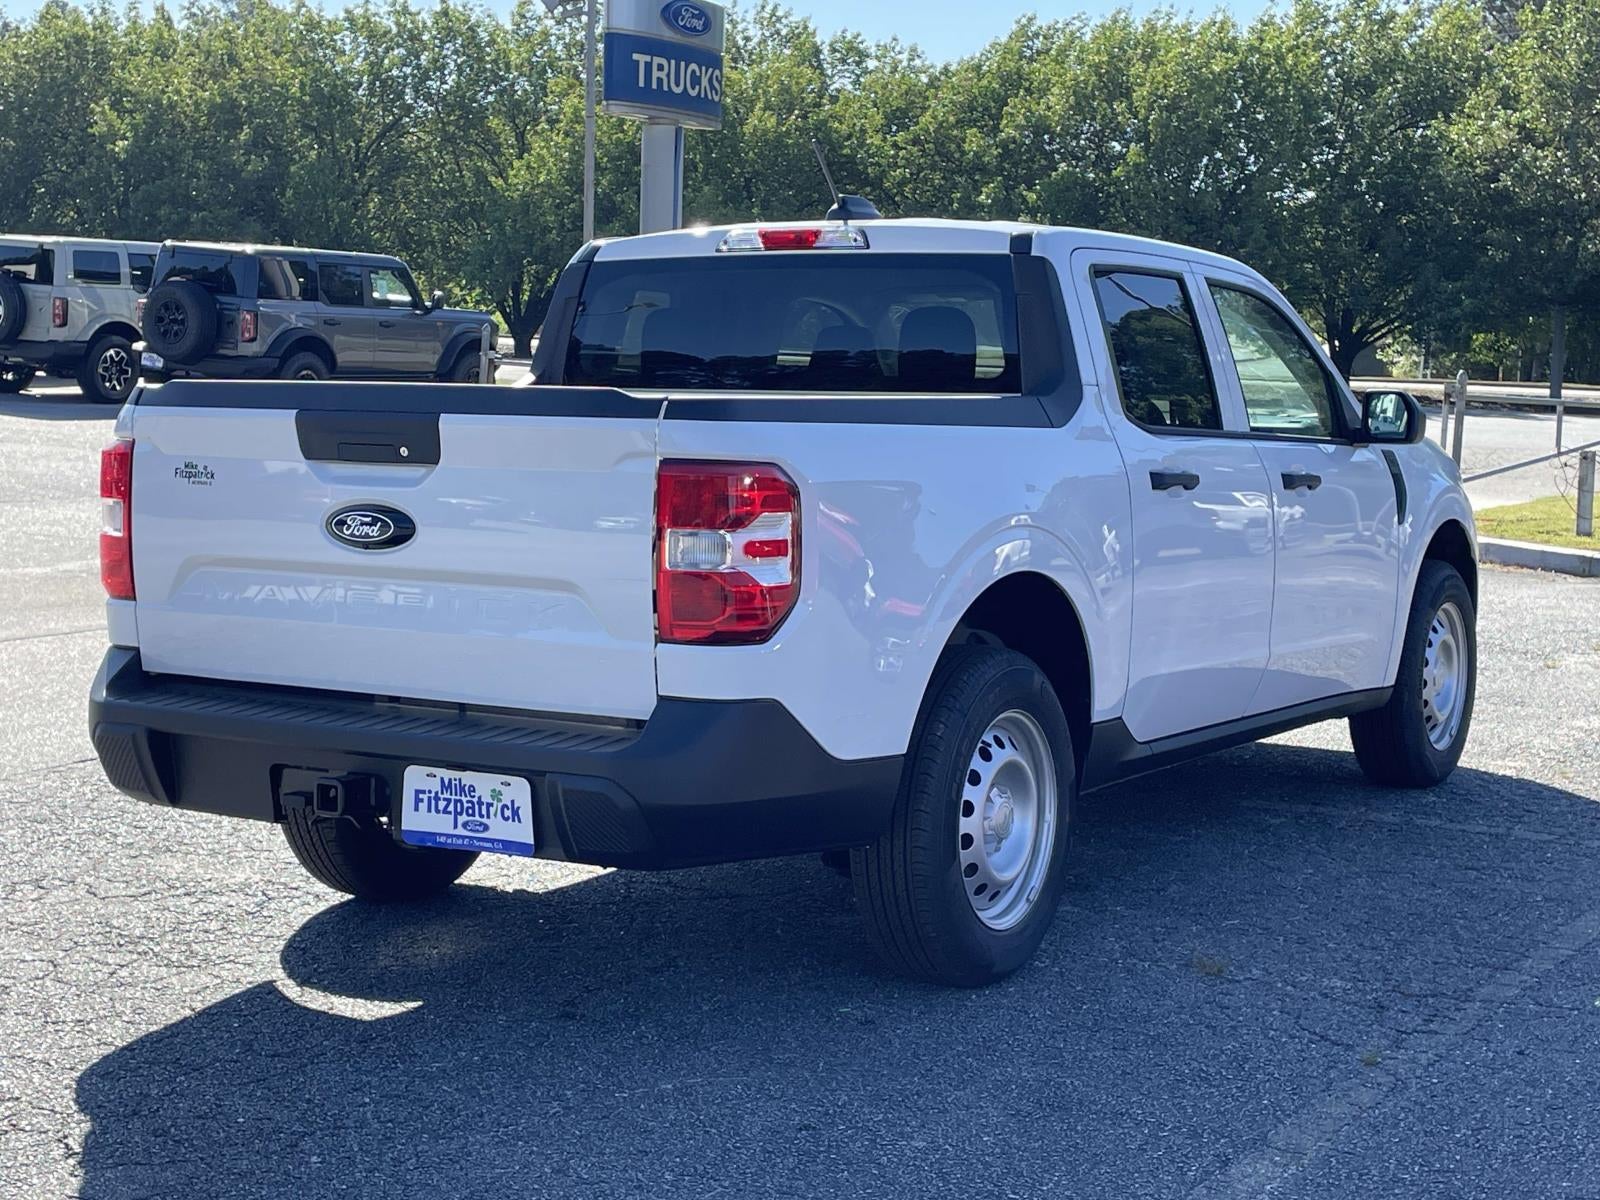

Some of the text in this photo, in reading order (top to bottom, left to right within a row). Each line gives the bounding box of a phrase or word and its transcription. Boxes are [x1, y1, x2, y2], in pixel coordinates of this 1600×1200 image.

[678, 6, 705, 31] Ford
[632, 52, 721, 102] TRUCKS
[174, 467, 215, 484] Fitzpatrick
[184, 460, 198, 470] Mike
[343, 515, 382, 537] Ford
[440, 776, 477, 799] Mike
[413, 788, 522, 830] Fitzpatrick
[466, 821, 485, 832] Ford
